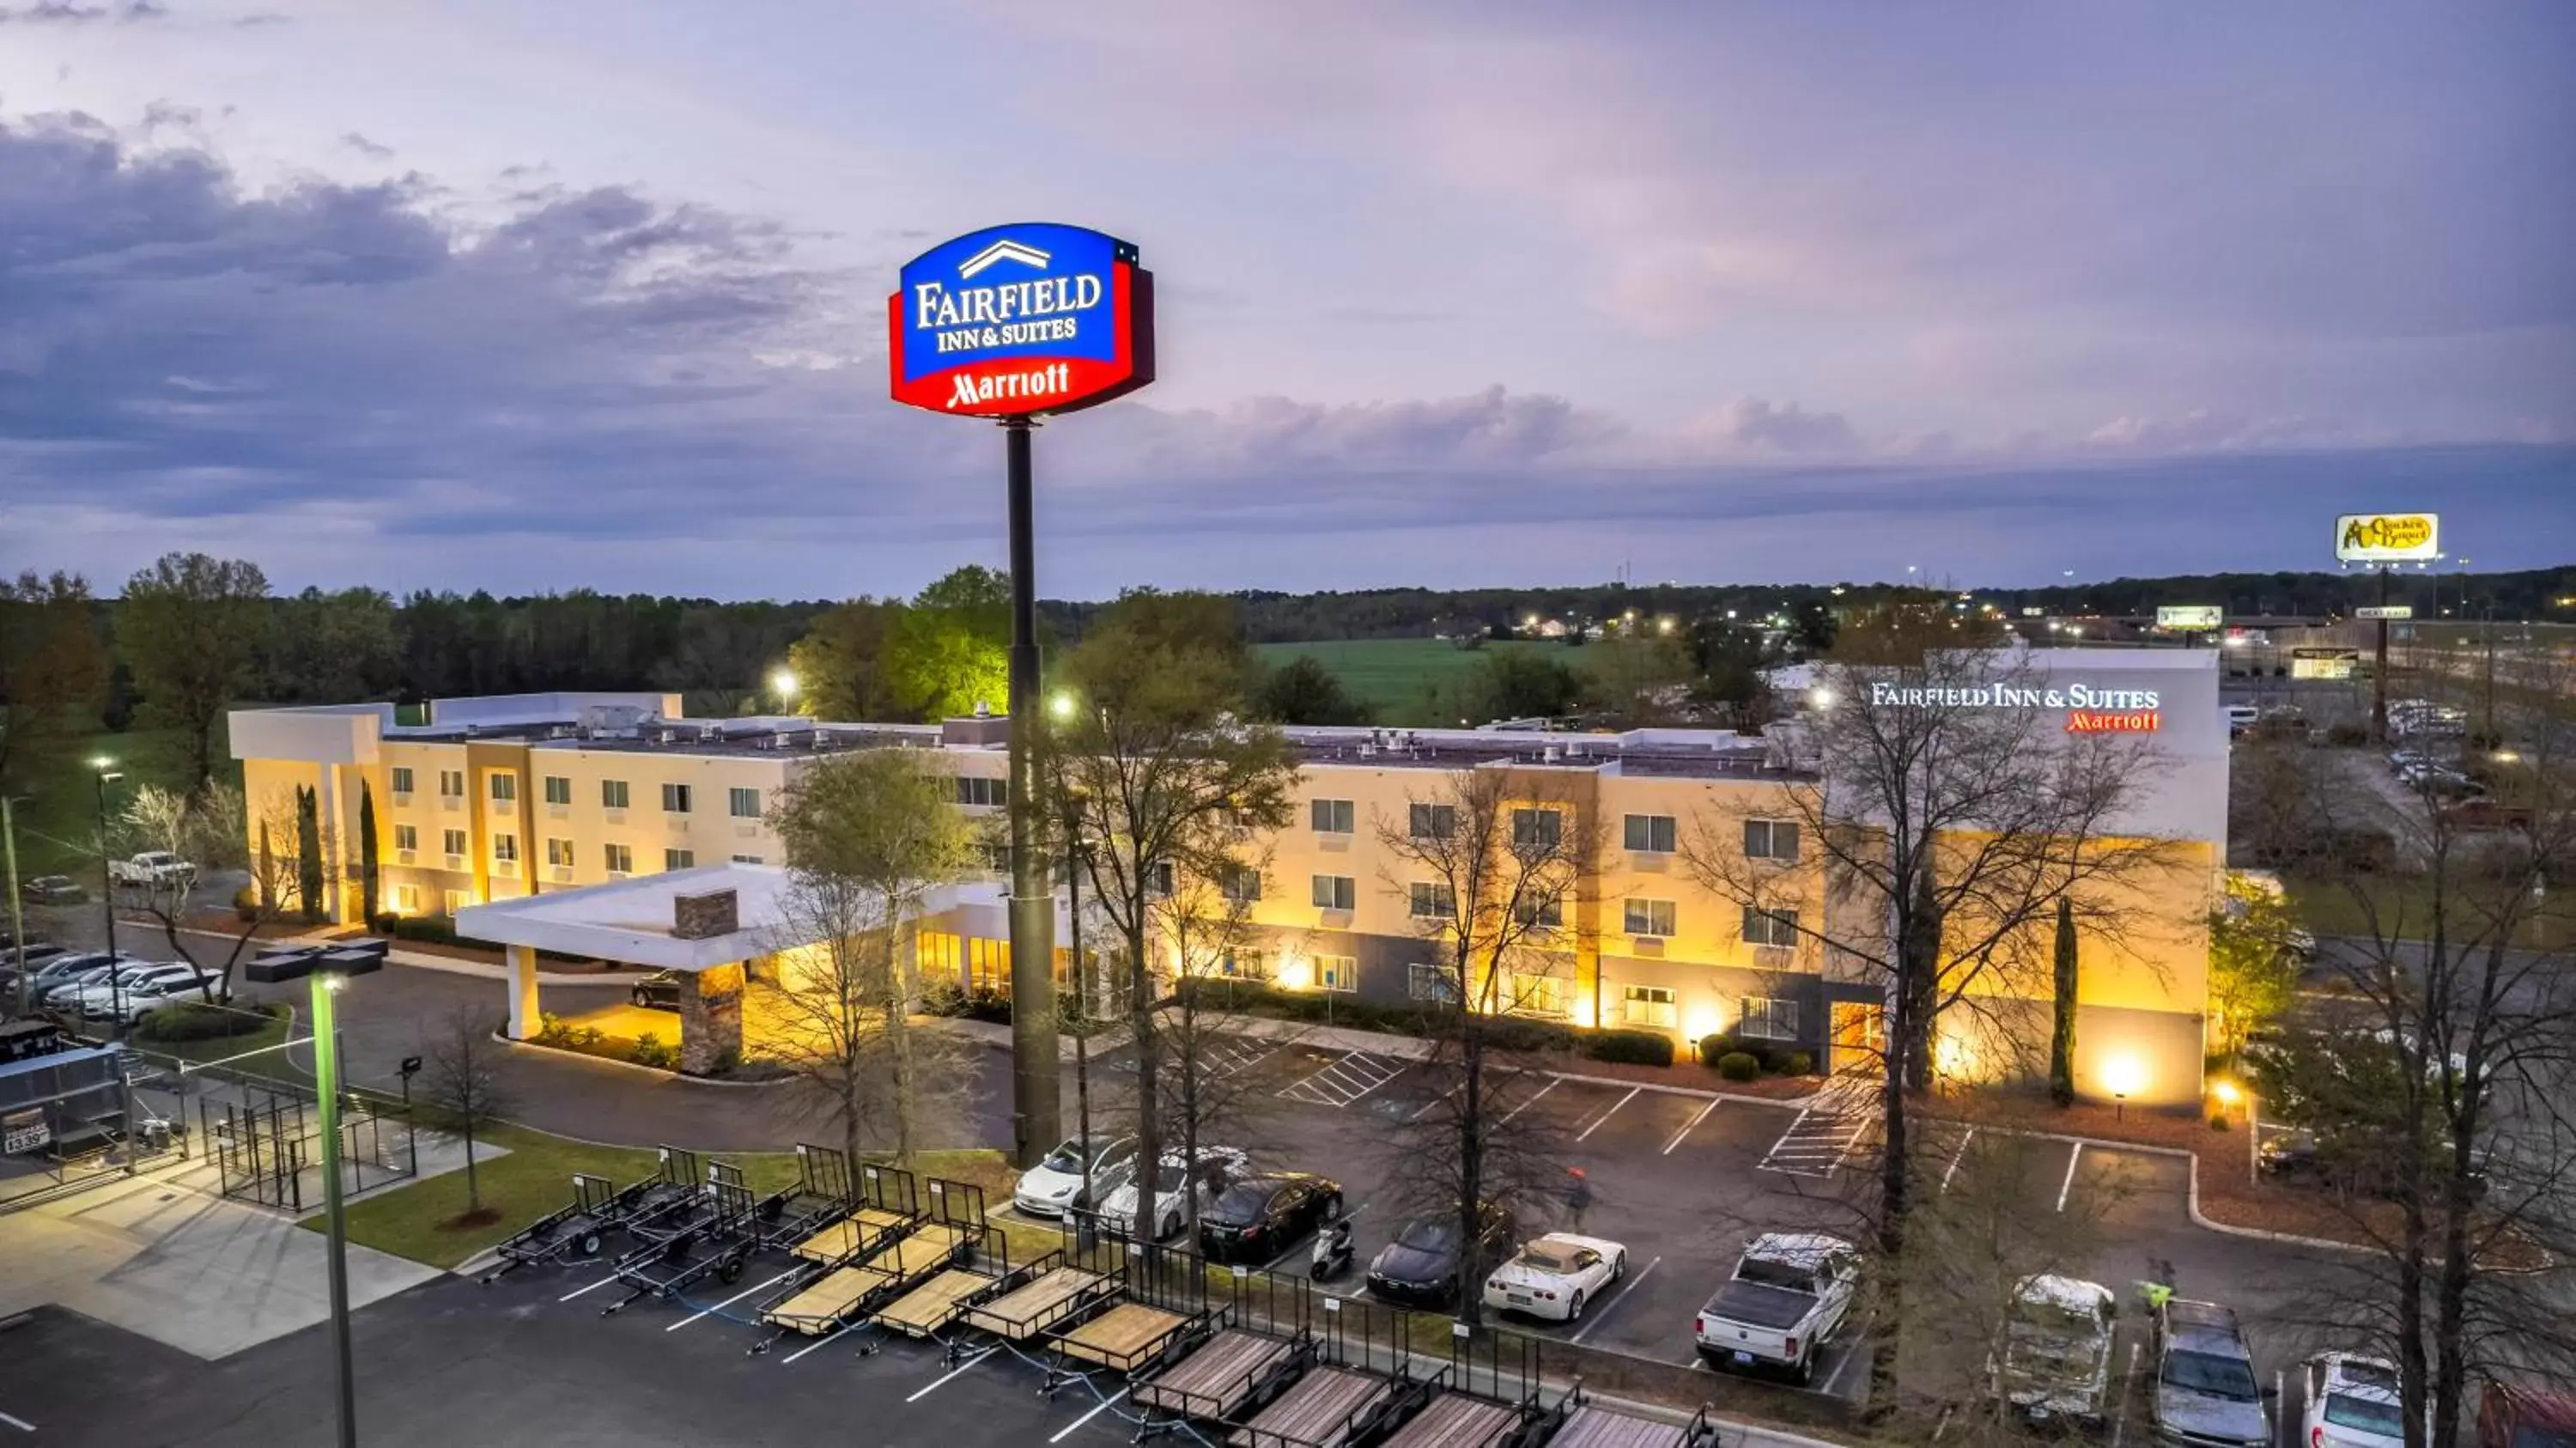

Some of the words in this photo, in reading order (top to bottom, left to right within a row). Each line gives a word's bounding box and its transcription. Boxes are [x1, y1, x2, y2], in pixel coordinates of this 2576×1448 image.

[915, 275, 1102, 329] FAIRFIELD
[938, 329, 979, 353] INN
[982, 325, 999, 346] &
[1001, 317, 1076, 344] SUITES
[947, 362, 1068, 408] Marriott
[1871, 682, 1990, 708] FAIRFIELD
[1993, 684, 2040, 707] INN
[2044, 689, 2065, 708] &
[2069, 683, 2160, 709] SUITES
[2067, 711, 2159, 731] Marriott
